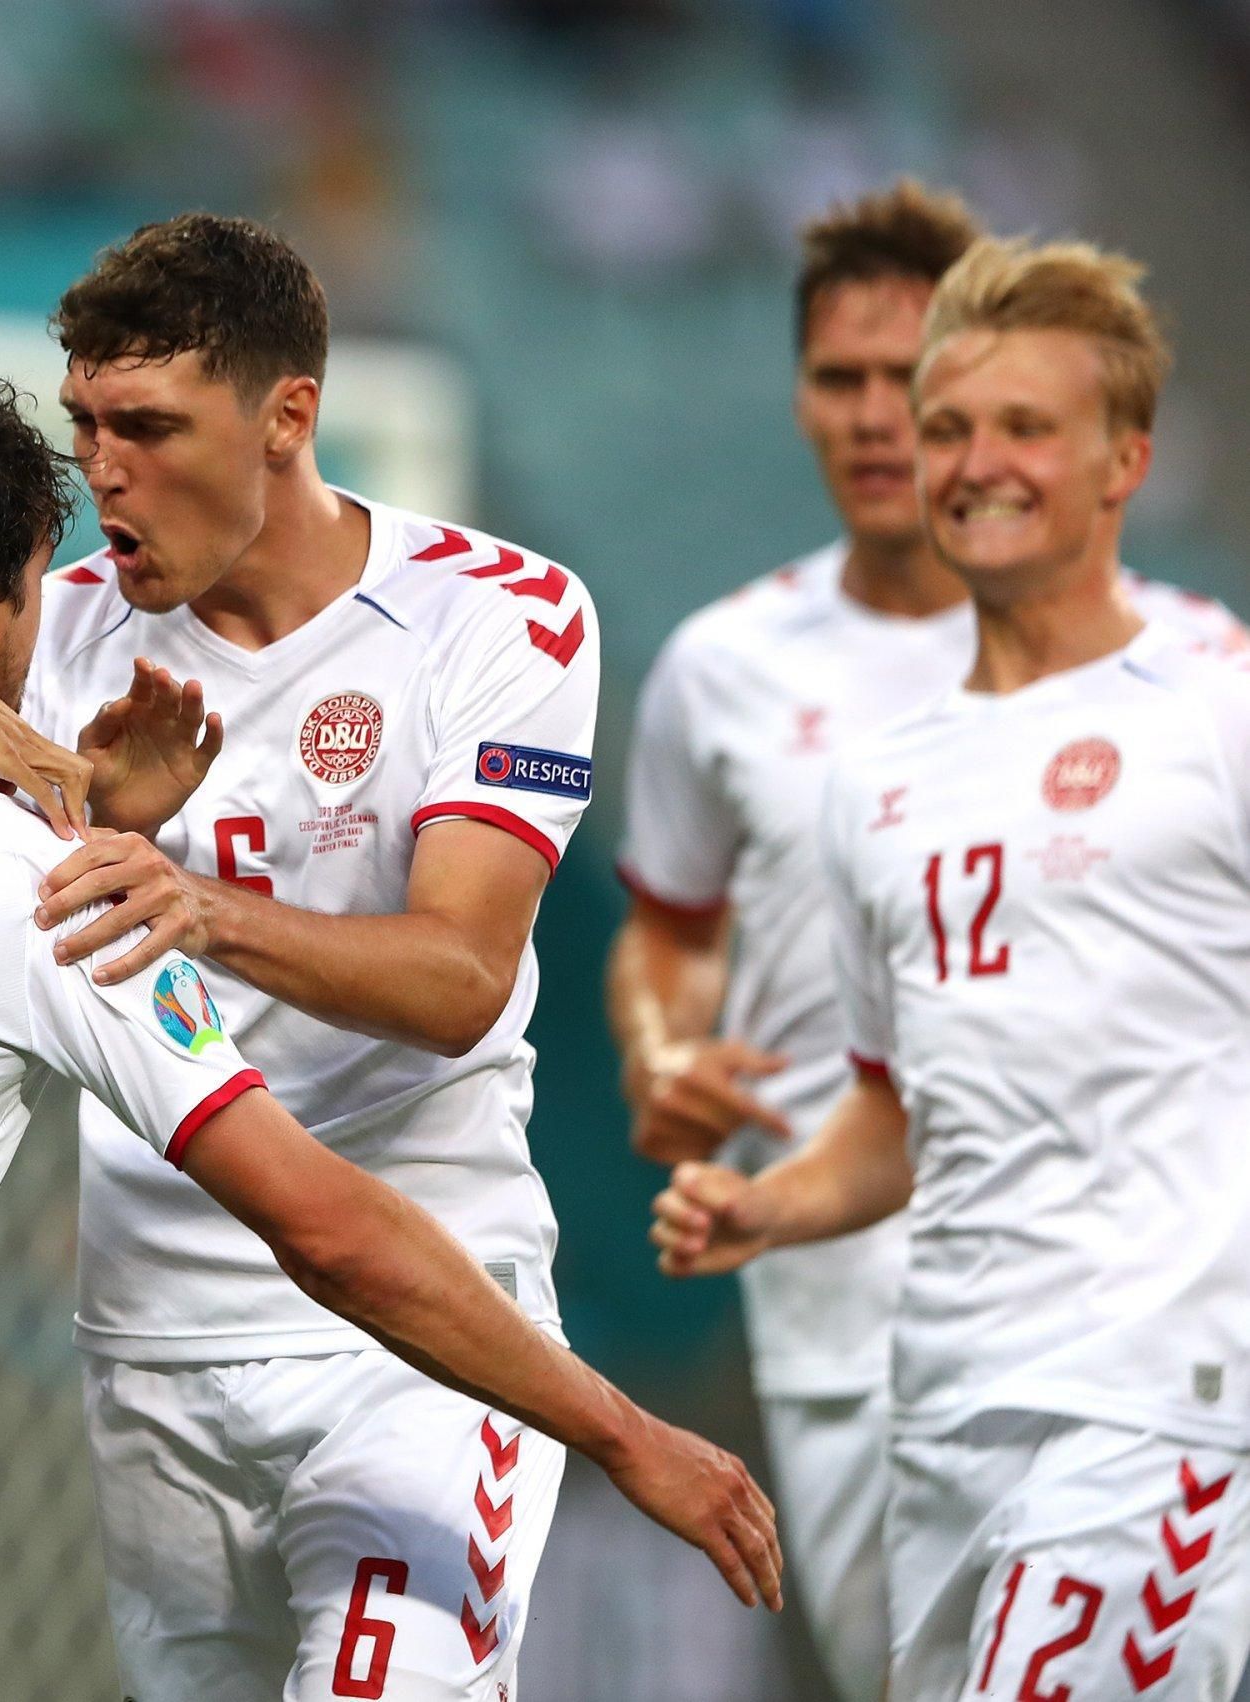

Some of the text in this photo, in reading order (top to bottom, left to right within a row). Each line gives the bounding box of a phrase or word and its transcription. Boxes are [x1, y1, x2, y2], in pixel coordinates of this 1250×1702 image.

[301, 717, 320, 772] DANSK
[317, 722, 370, 751] DBU
[322, 769, 357, 783] 1889
[515, 758, 591, 788] RESPECT
[349, 814, 379, 825] DENMARK
[337, 838, 359, 848] FINALS
[924, 842, 1011, 983] 12
[332, 1556, 409, 1700] 6
[978, 1560, 1106, 1702] 12
